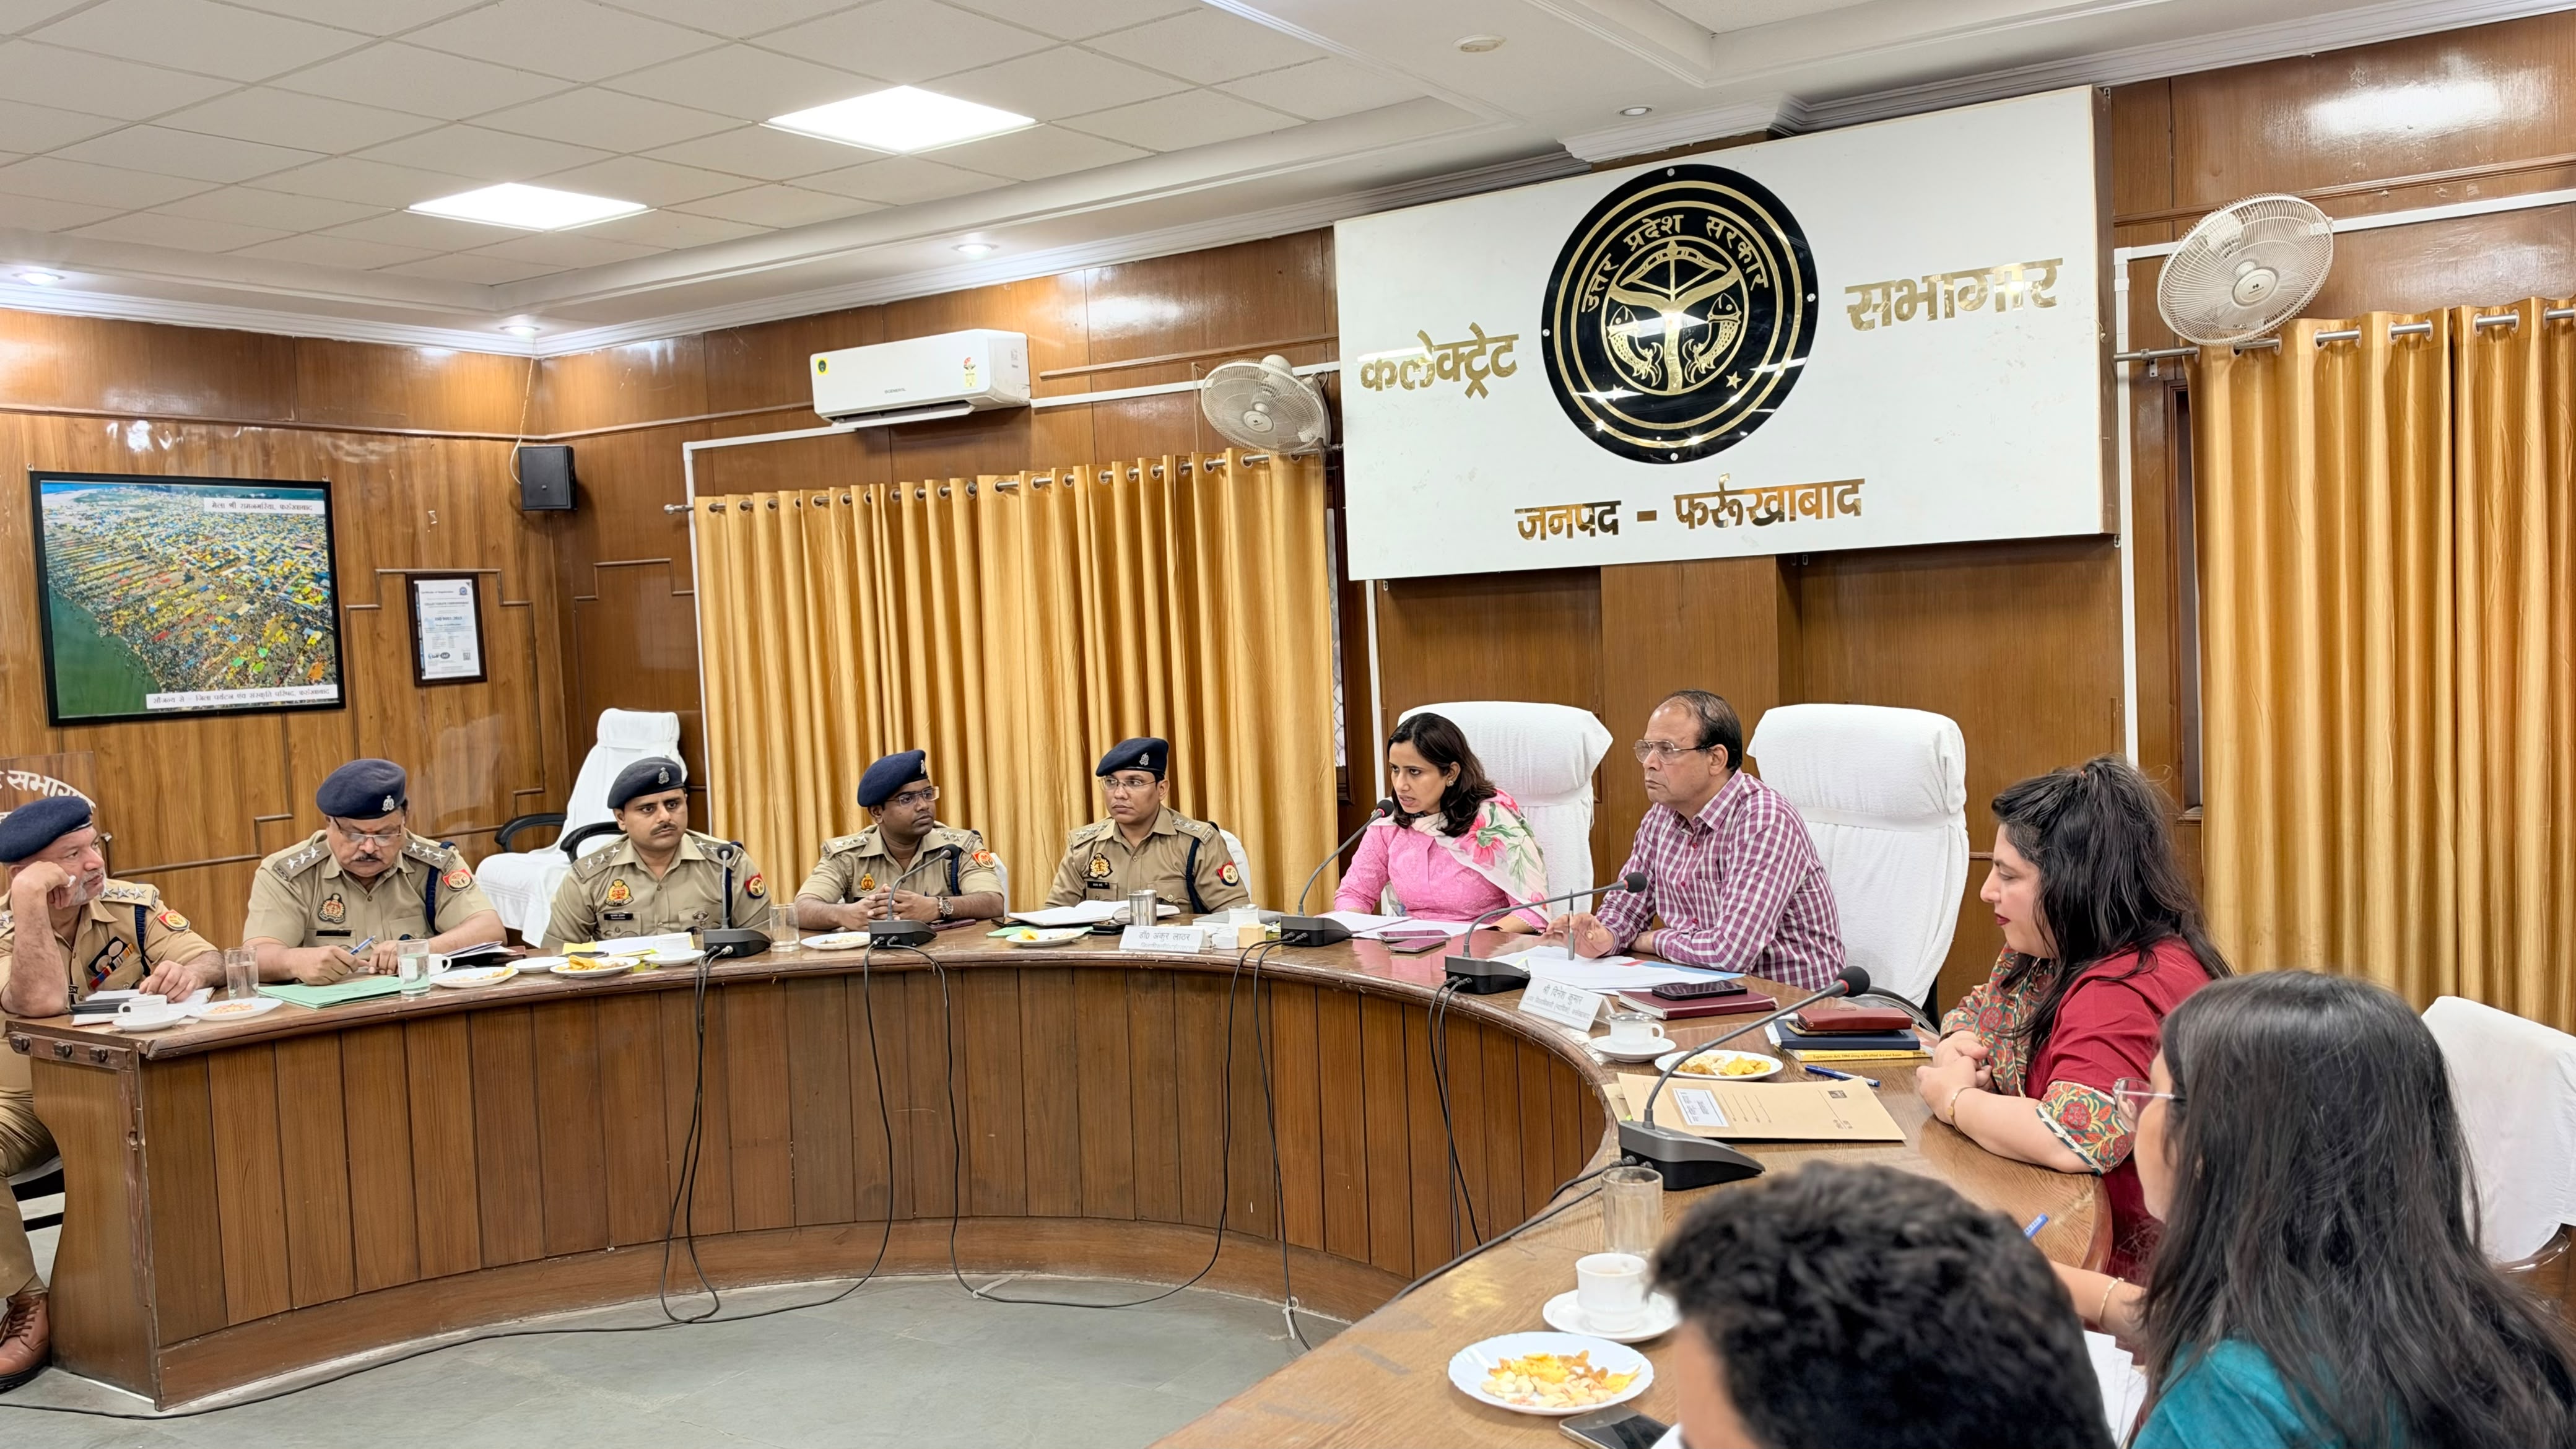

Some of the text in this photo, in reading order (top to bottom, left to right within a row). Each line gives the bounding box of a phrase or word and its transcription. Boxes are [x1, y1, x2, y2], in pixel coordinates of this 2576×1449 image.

[1581, 214, 1769, 313] उत्तर प्रदेश सरकार
[1844, 257, 2063, 331] सभागार
[1358, 321, 1520, 399] कलेक्ट्रेट
[1515, 500, 1622, 541] जनपद
[1567, 993, 1584, 1006] कुमार
